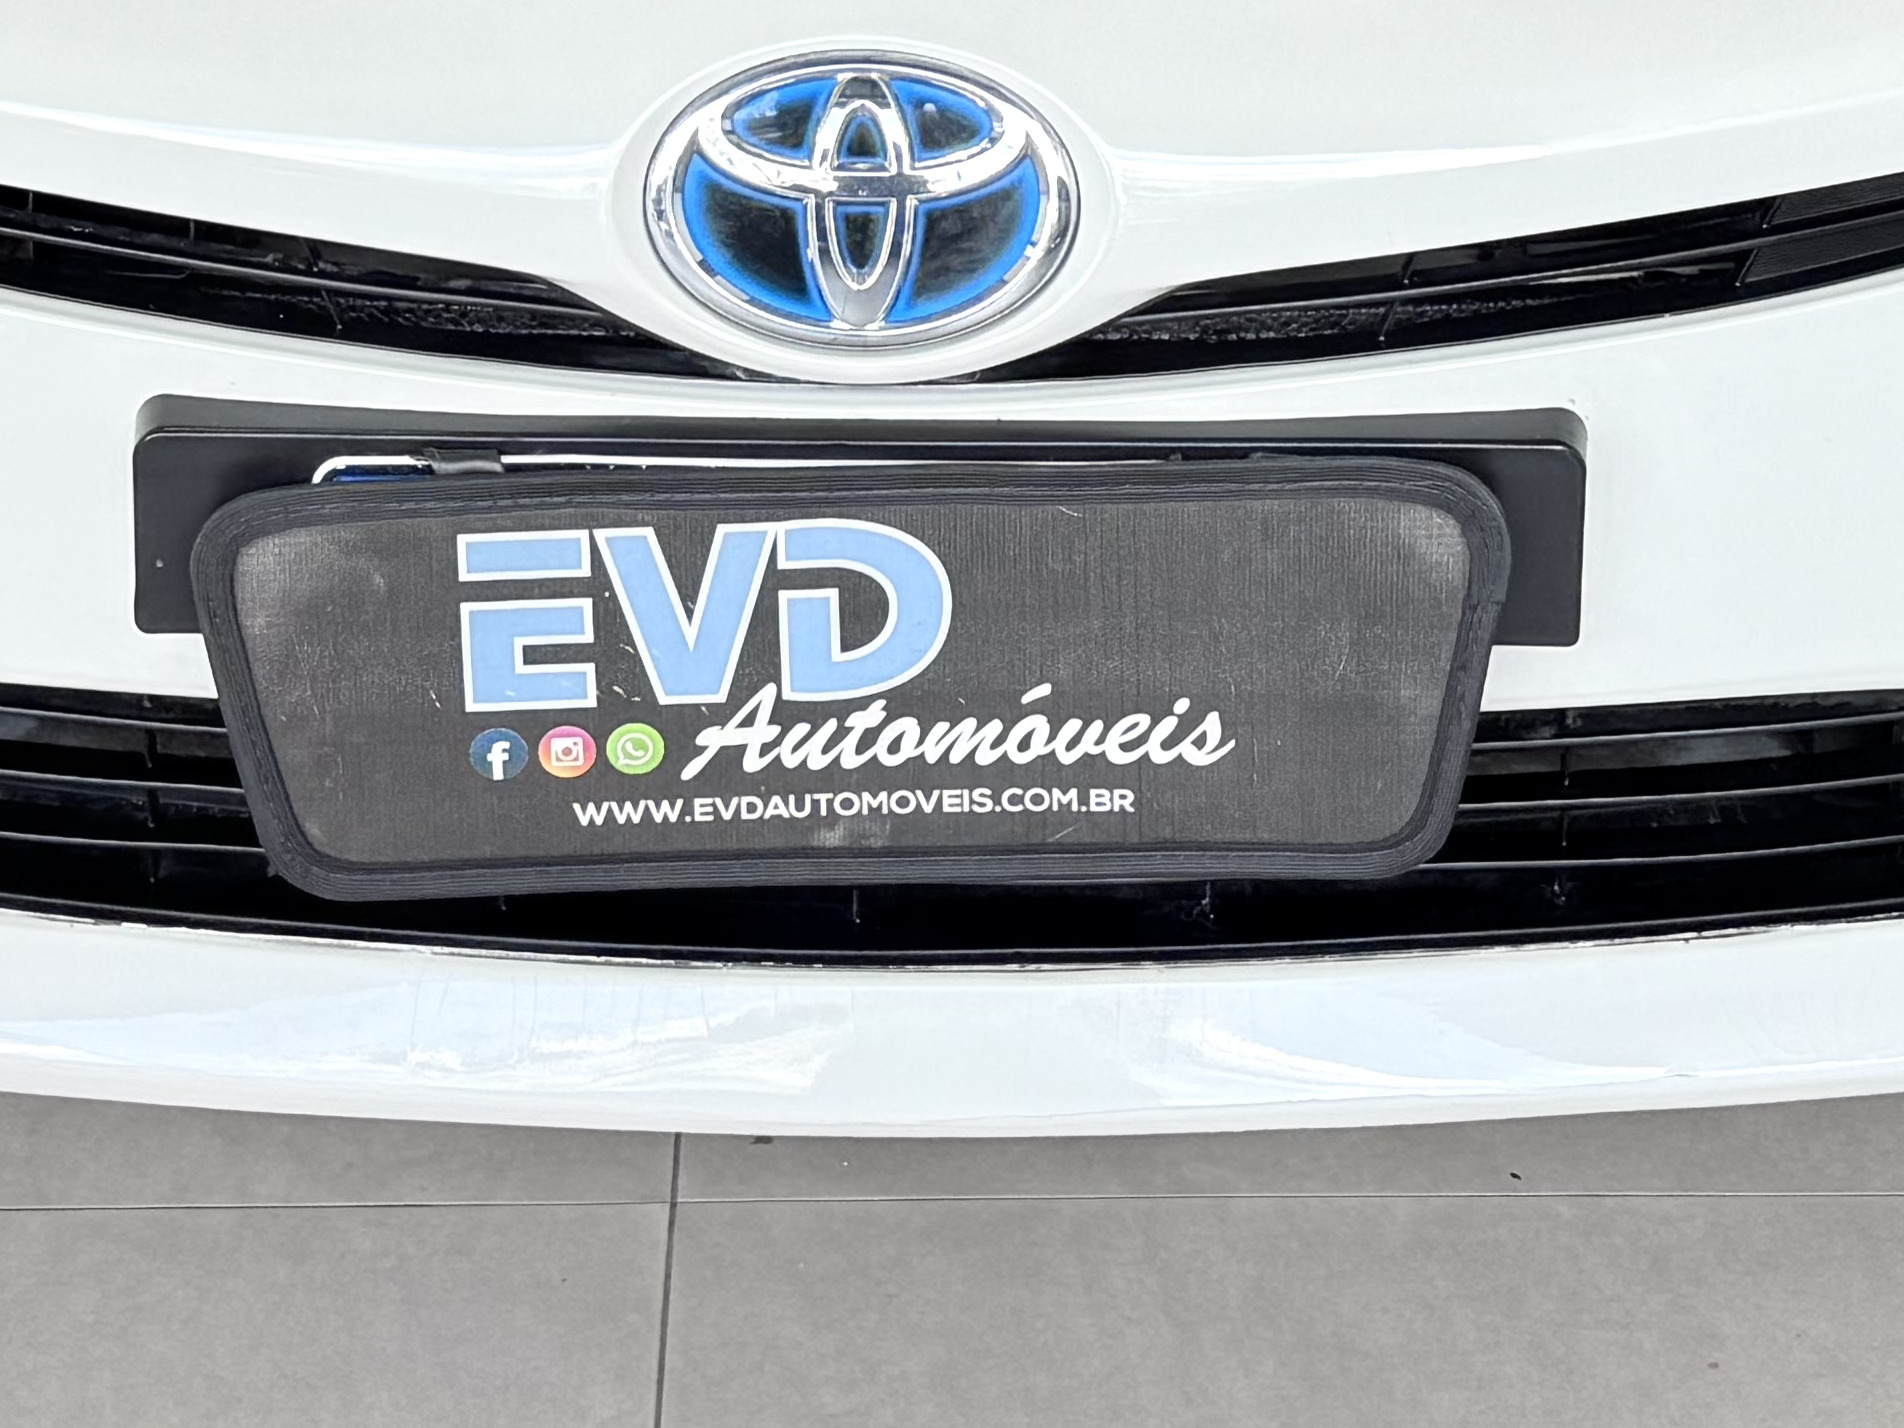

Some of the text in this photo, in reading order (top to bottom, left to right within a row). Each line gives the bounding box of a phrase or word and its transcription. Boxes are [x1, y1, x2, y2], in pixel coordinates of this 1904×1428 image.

[457, 518, 953, 713] EVD
[680, 682, 1236, 781] Automóveis
[573, 787, 1136, 826] WWW.EVDAUTOMOVEIS.COM.BR
